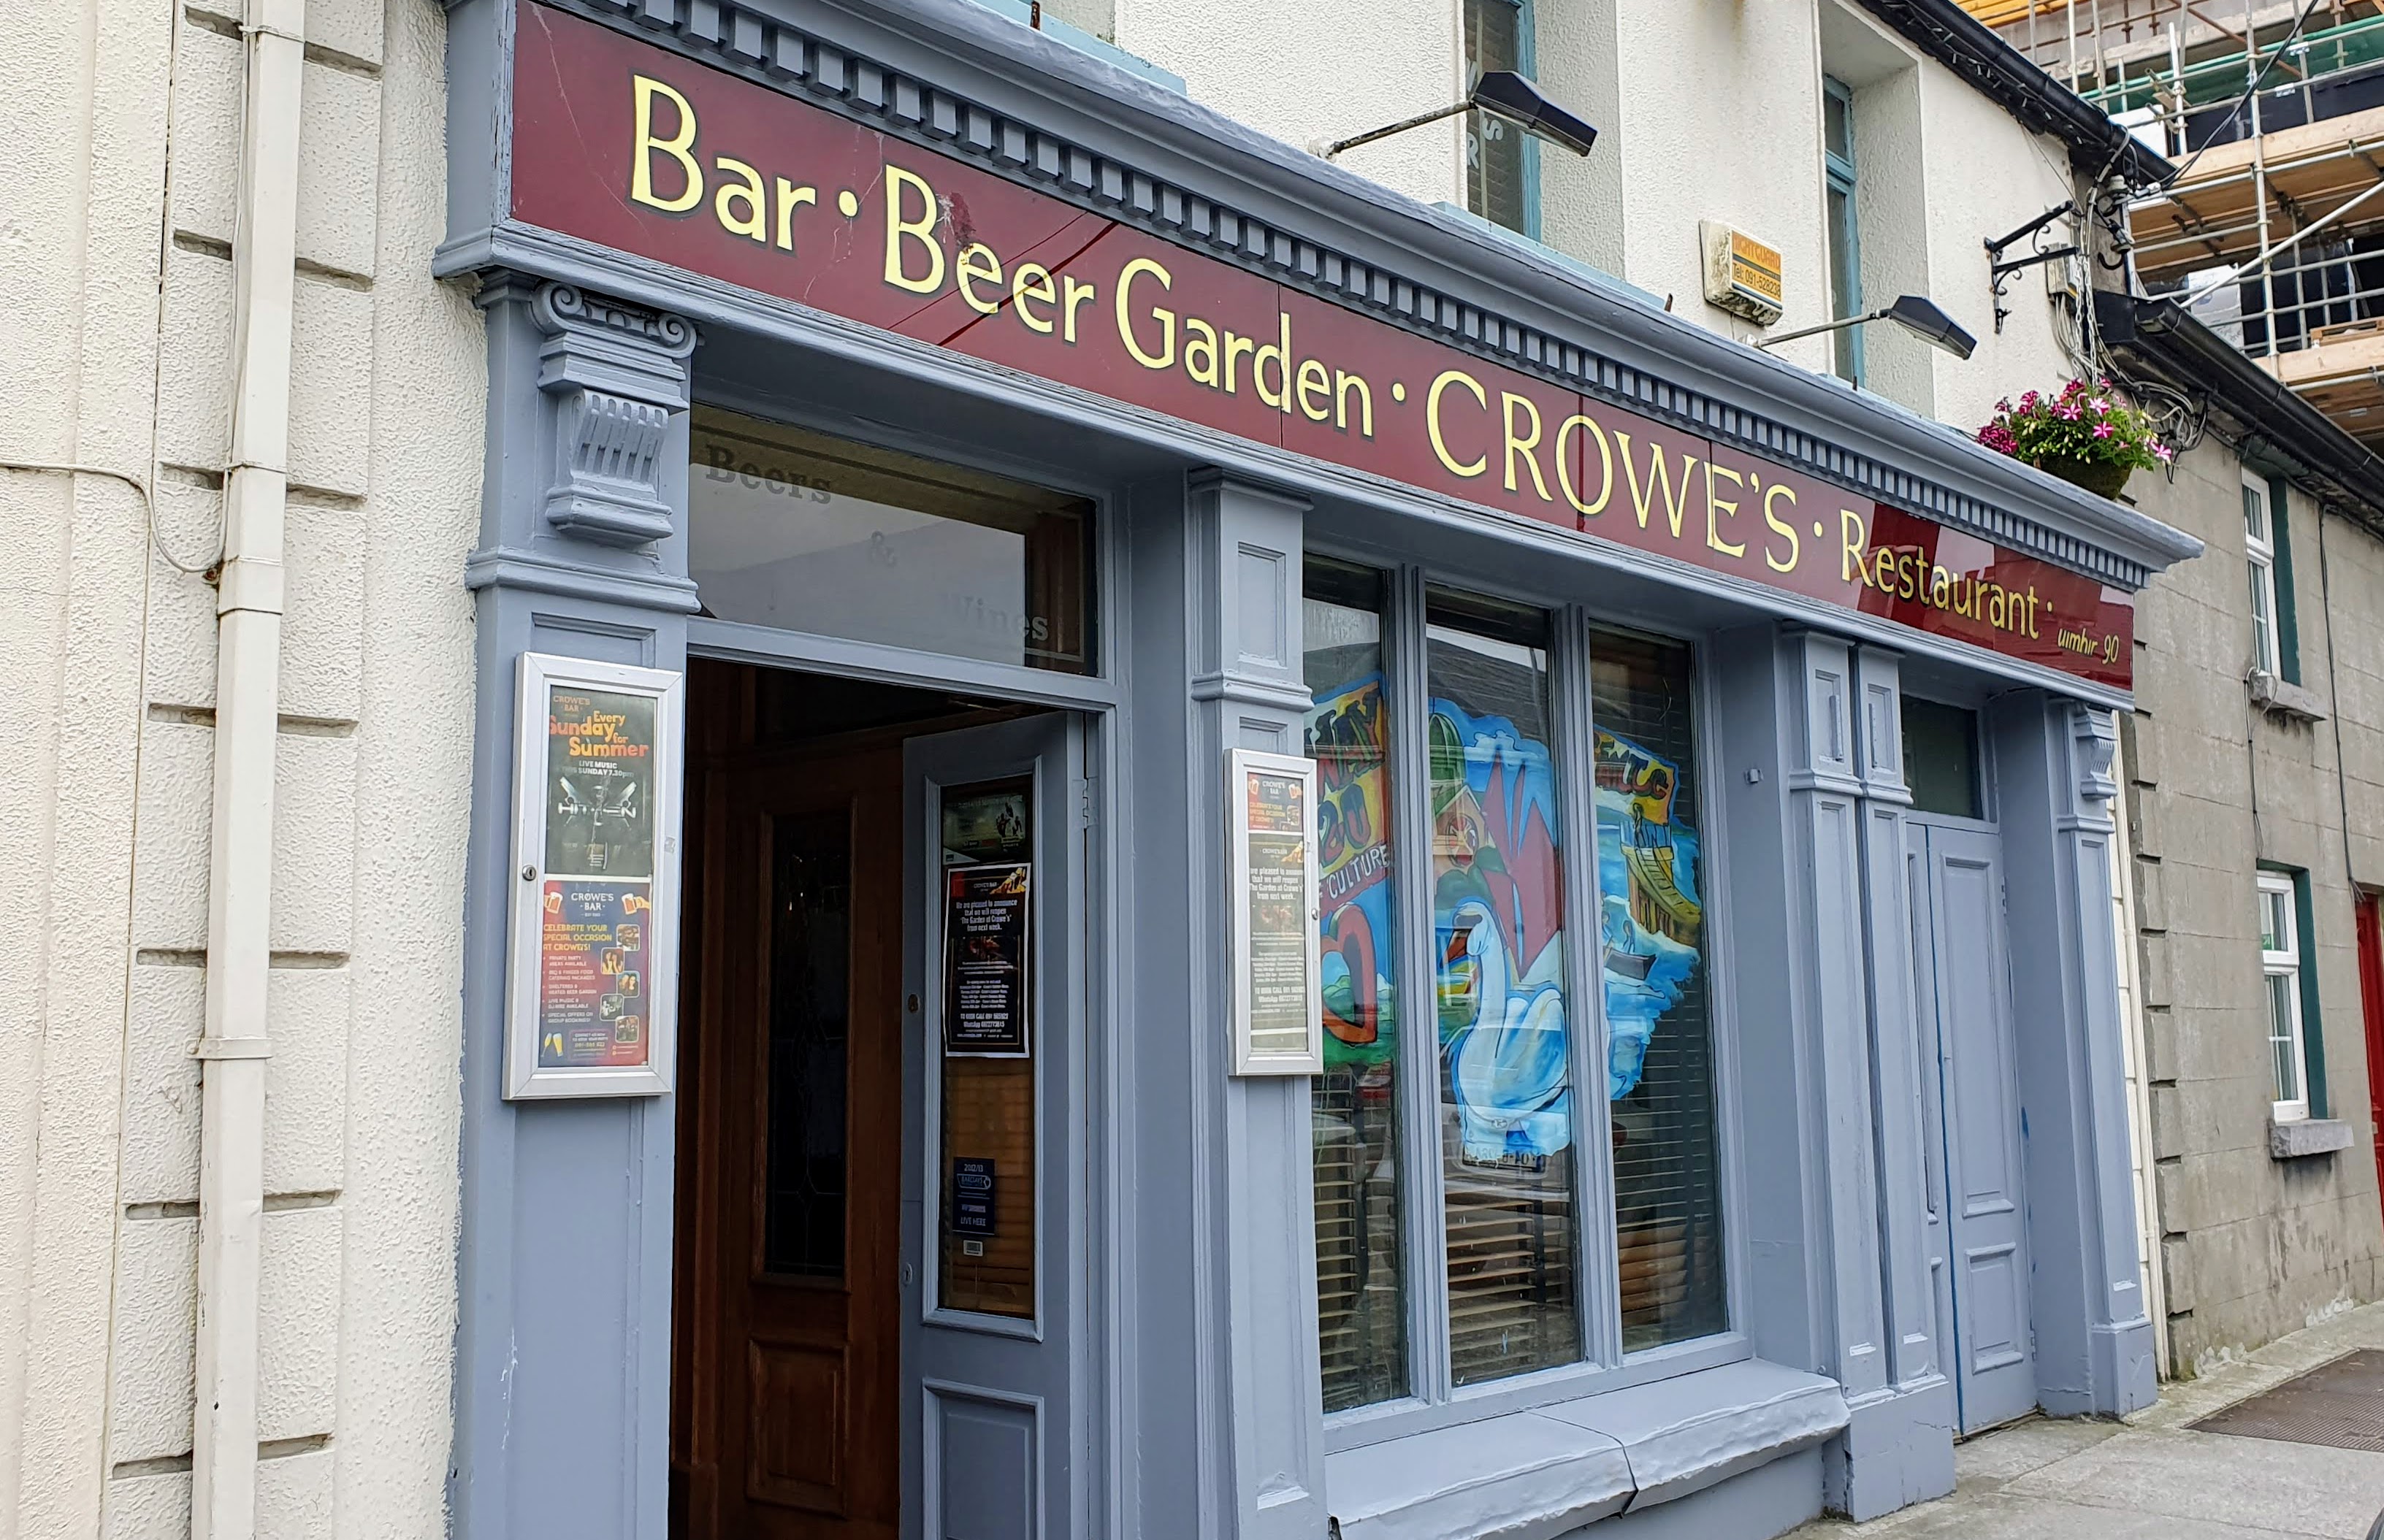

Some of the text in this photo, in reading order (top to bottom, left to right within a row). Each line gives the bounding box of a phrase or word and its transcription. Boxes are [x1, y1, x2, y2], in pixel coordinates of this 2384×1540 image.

[633, 75, 814, 248] Bar
[885, 166, 1093, 340] Beer
[1117, 258, 1372, 436] Garden
[1429, 371, 1798, 573] CROWE'S
[1841, 510, 2039, 639] Restaurant
[2102, 635, 2119, 664] 90
[706, 443, 831, 505] Beers
[553, 695, 591, 705] CROWE'S
[593, 710, 625, 727] Every
[550, 716, 616, 743] Sunday
[613, 732, 629, 743] for
[569, 736, 649, 757] Summer
[595, 761, 618, 770] MUSIC
[578, 767, 608, 776] SUNDAY
[1327, 844, 1388, 900] CULTURE
[571, 892, 614, 902] CROWE'S
[584, 903, 602, 911] BAR
[543, 924, 608, 932] CELEBRATE YOUR
[543, 933, 571, 941] SPECIAL
[960, 1216, 986, 1227] LIVE HERE
